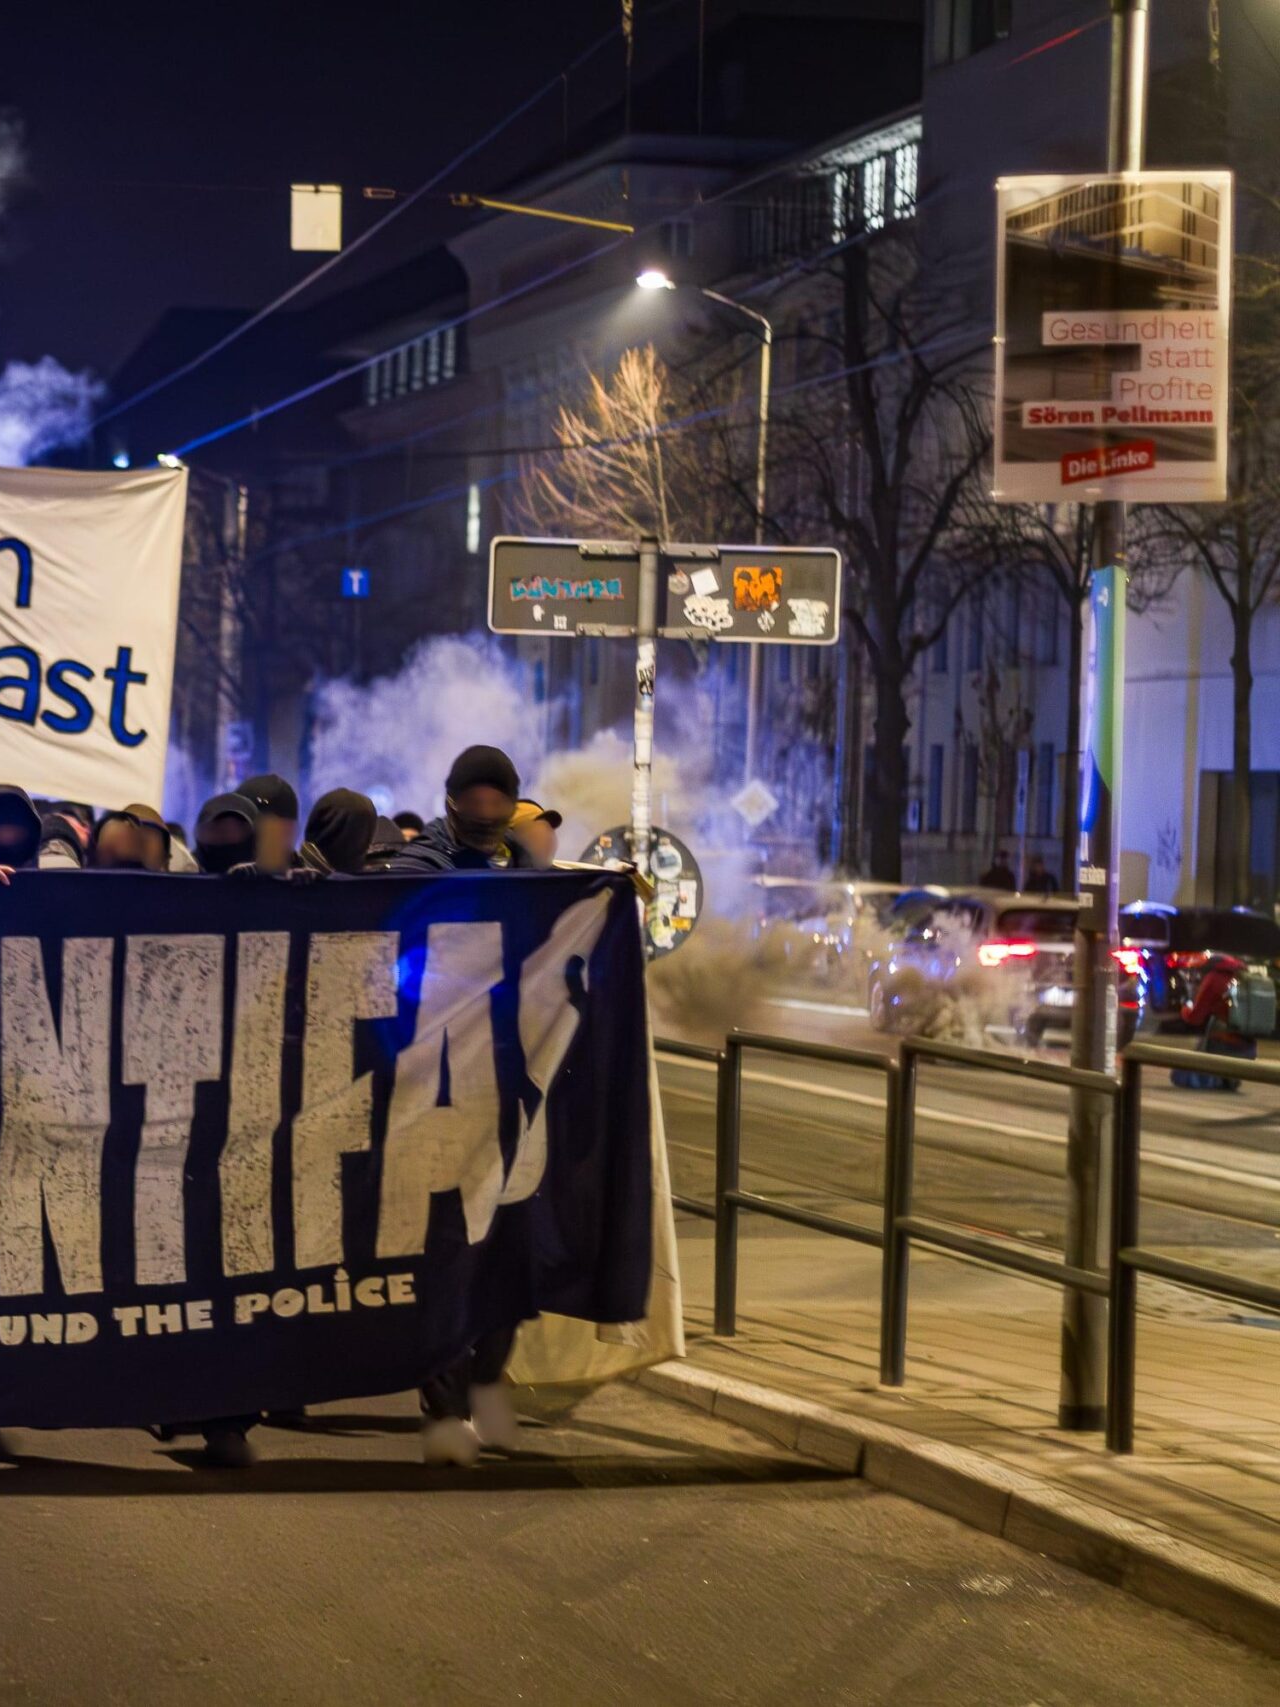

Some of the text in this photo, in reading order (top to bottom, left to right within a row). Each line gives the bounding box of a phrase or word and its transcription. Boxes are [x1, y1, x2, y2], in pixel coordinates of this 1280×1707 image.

[1050, 315, 1216, 341] Gesundheit
[1147, 347, 1213, 368] statt
[1120, 376, 1213, 400] Profite
[1028, 406, 1213, 424] Sören Pellmann
[1068, 449, 1150, 478] Die Linke
[113, 1299, 214, 1337] THE
